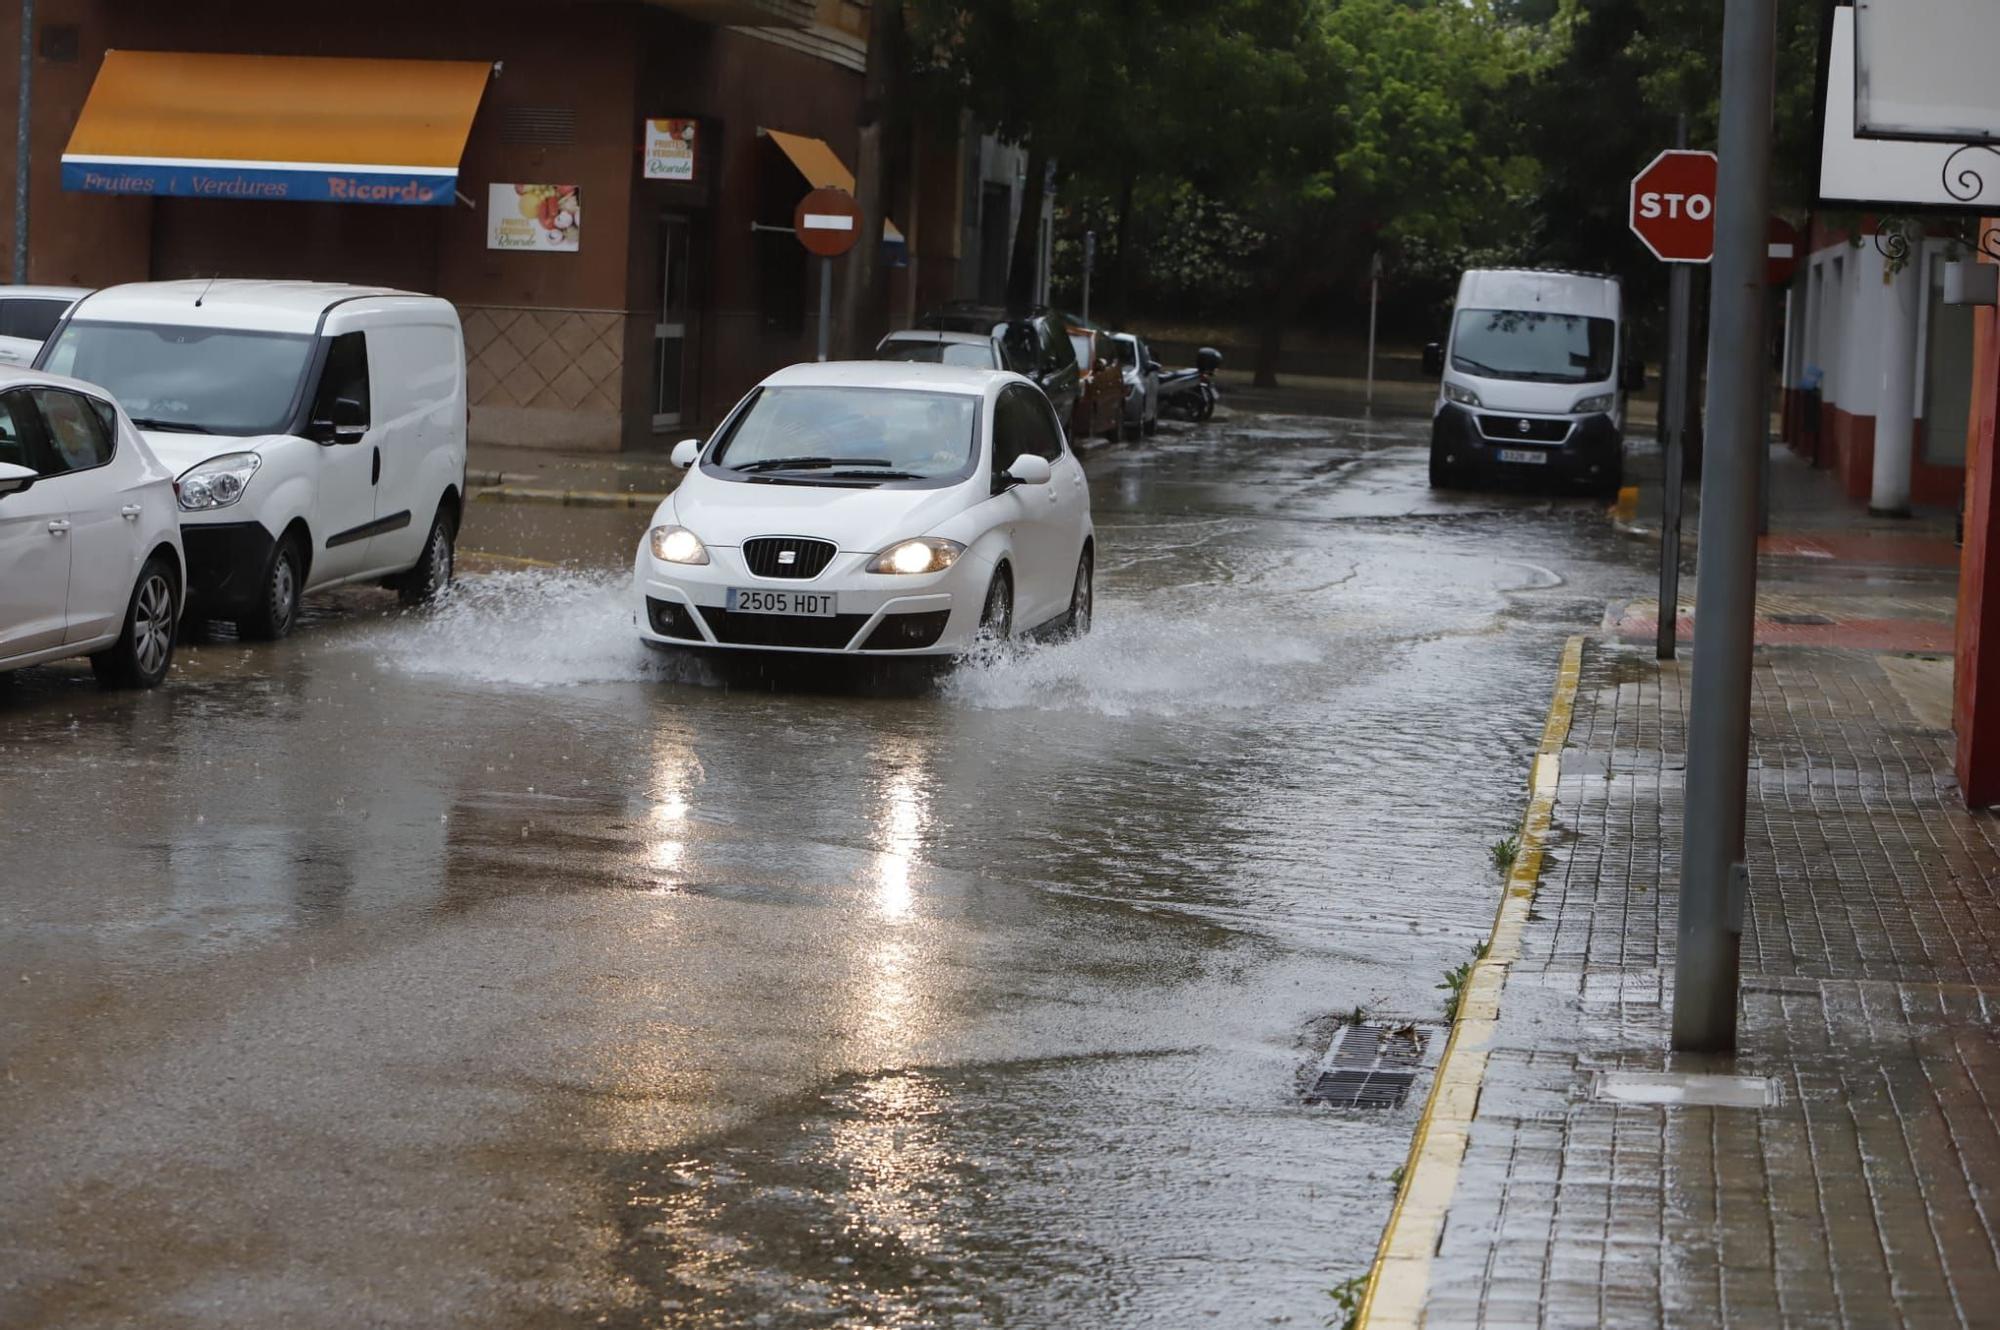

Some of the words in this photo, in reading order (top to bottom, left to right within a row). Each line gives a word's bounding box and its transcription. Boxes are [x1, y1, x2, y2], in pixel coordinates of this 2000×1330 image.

[83, 173, 154, 192] Fruites
[192, 176, 288, 196] Verdures
[328, 177, 433, 201] Ricardo
[1640, 192, 1711, 220] STO
[740, 592, 787, 611] 2505
[795, 595, 831, 614] HDT
